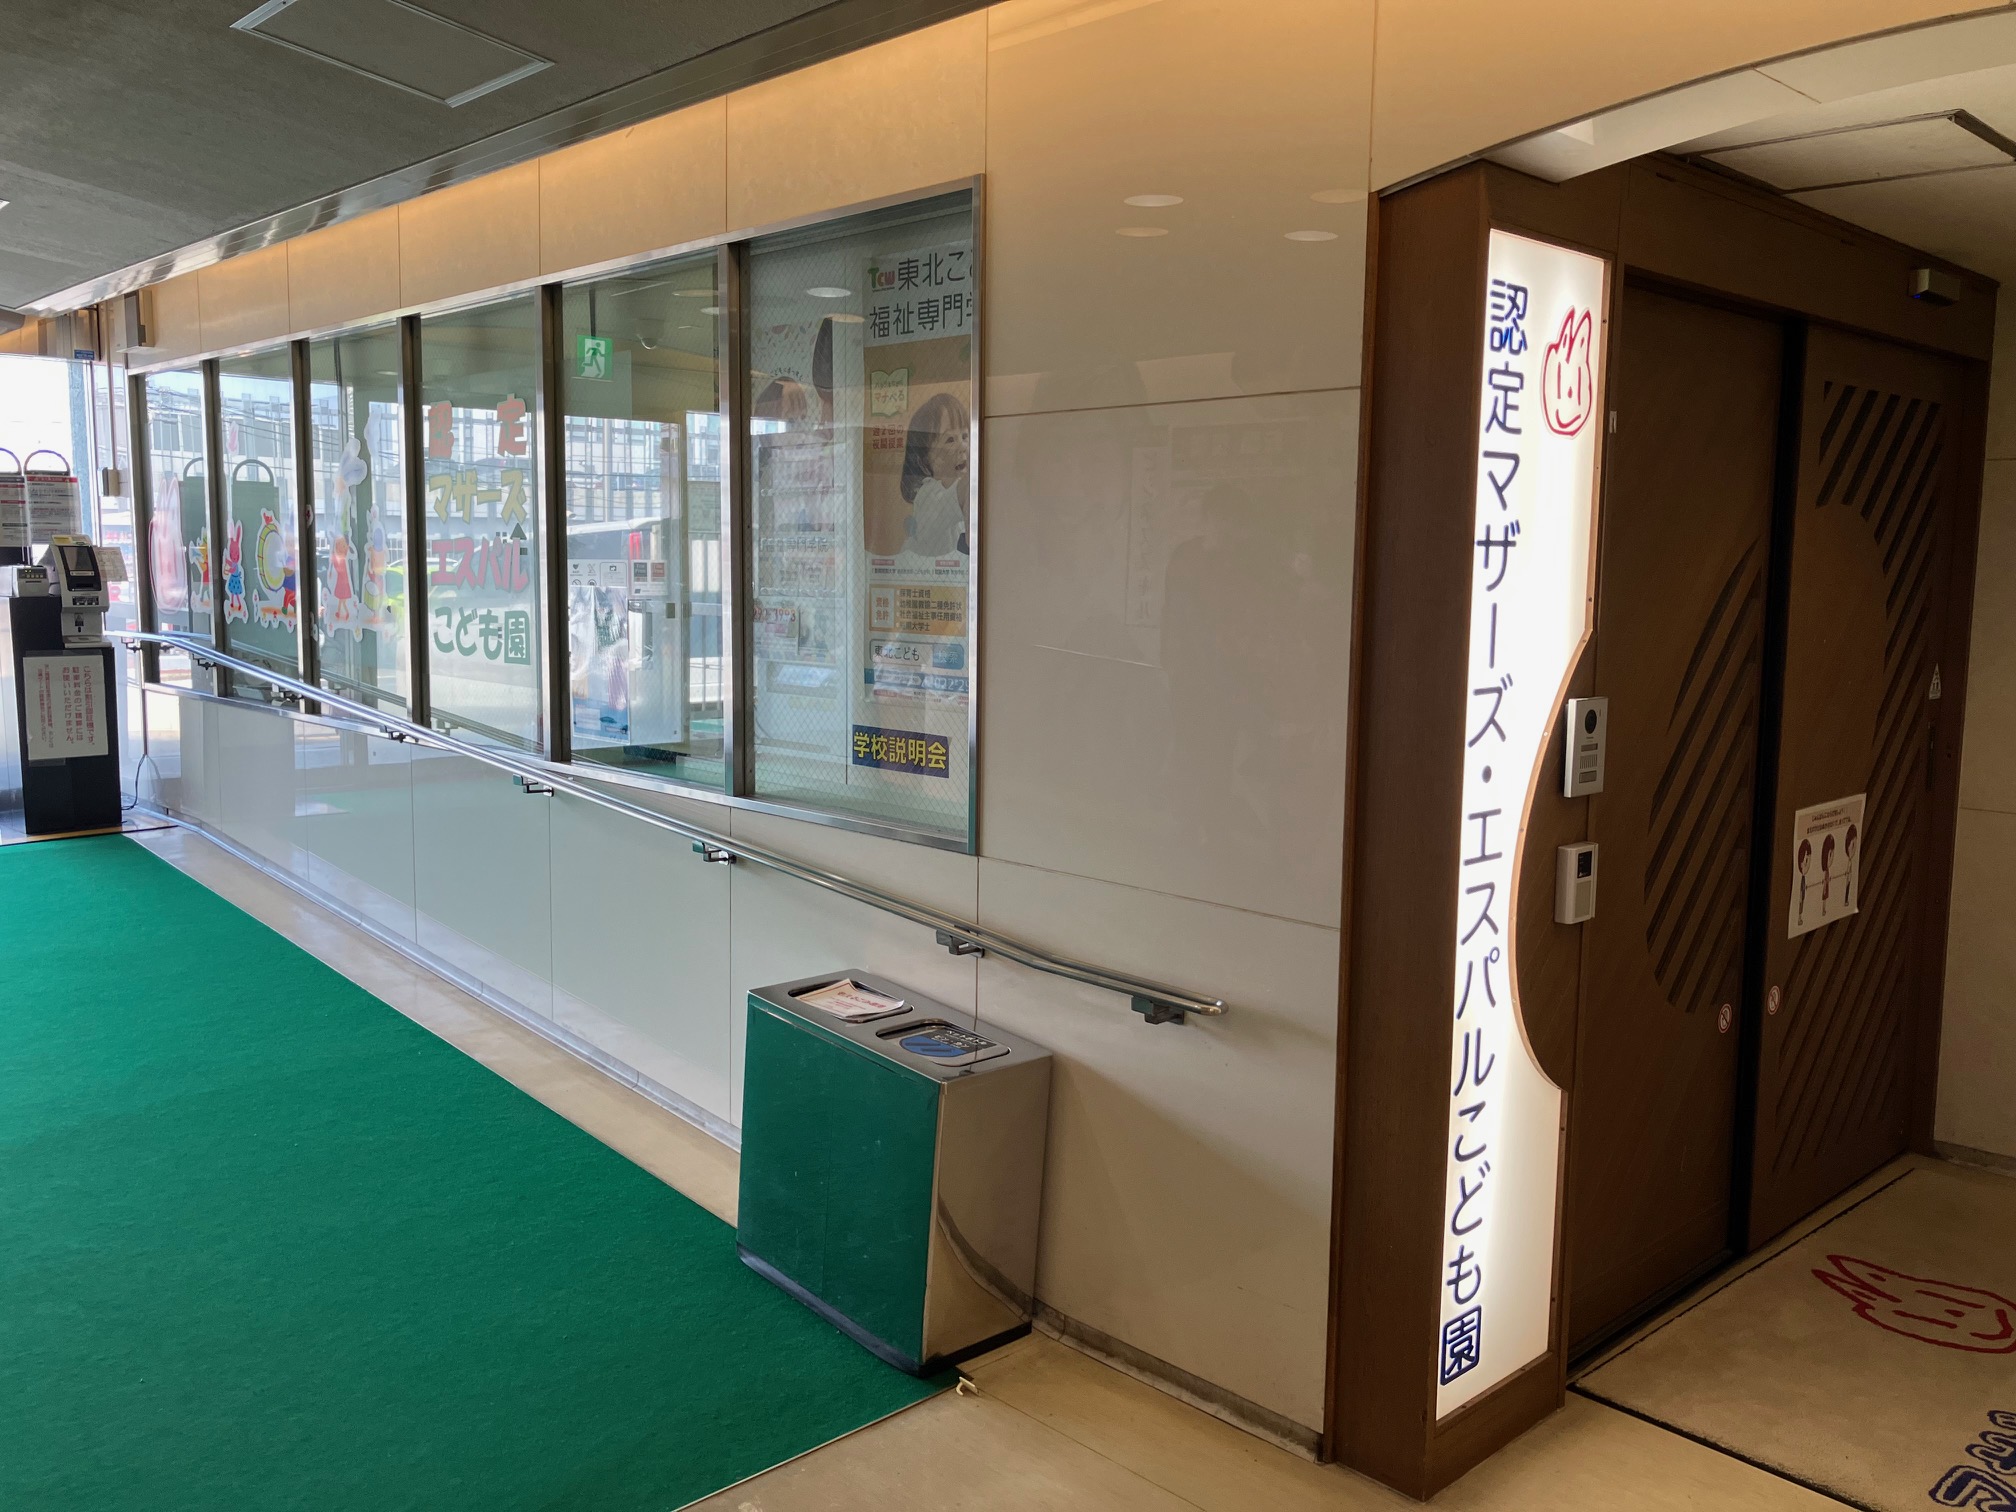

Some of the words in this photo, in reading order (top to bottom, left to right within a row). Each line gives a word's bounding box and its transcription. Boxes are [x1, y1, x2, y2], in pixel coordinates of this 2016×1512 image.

[897, 249, 972, 291] 東北こ
[429, 468, 528, 525] マザーズ
[431, 537, 530, 593] エスパル
[433, 606, 531, 666] こども園
[874, 645, 920, 661] 東北こども
[853, 732, 947, 770] 学校説明会
[1440, 280, 1529, 1387] 認定マザーズ・エスパルこども園
